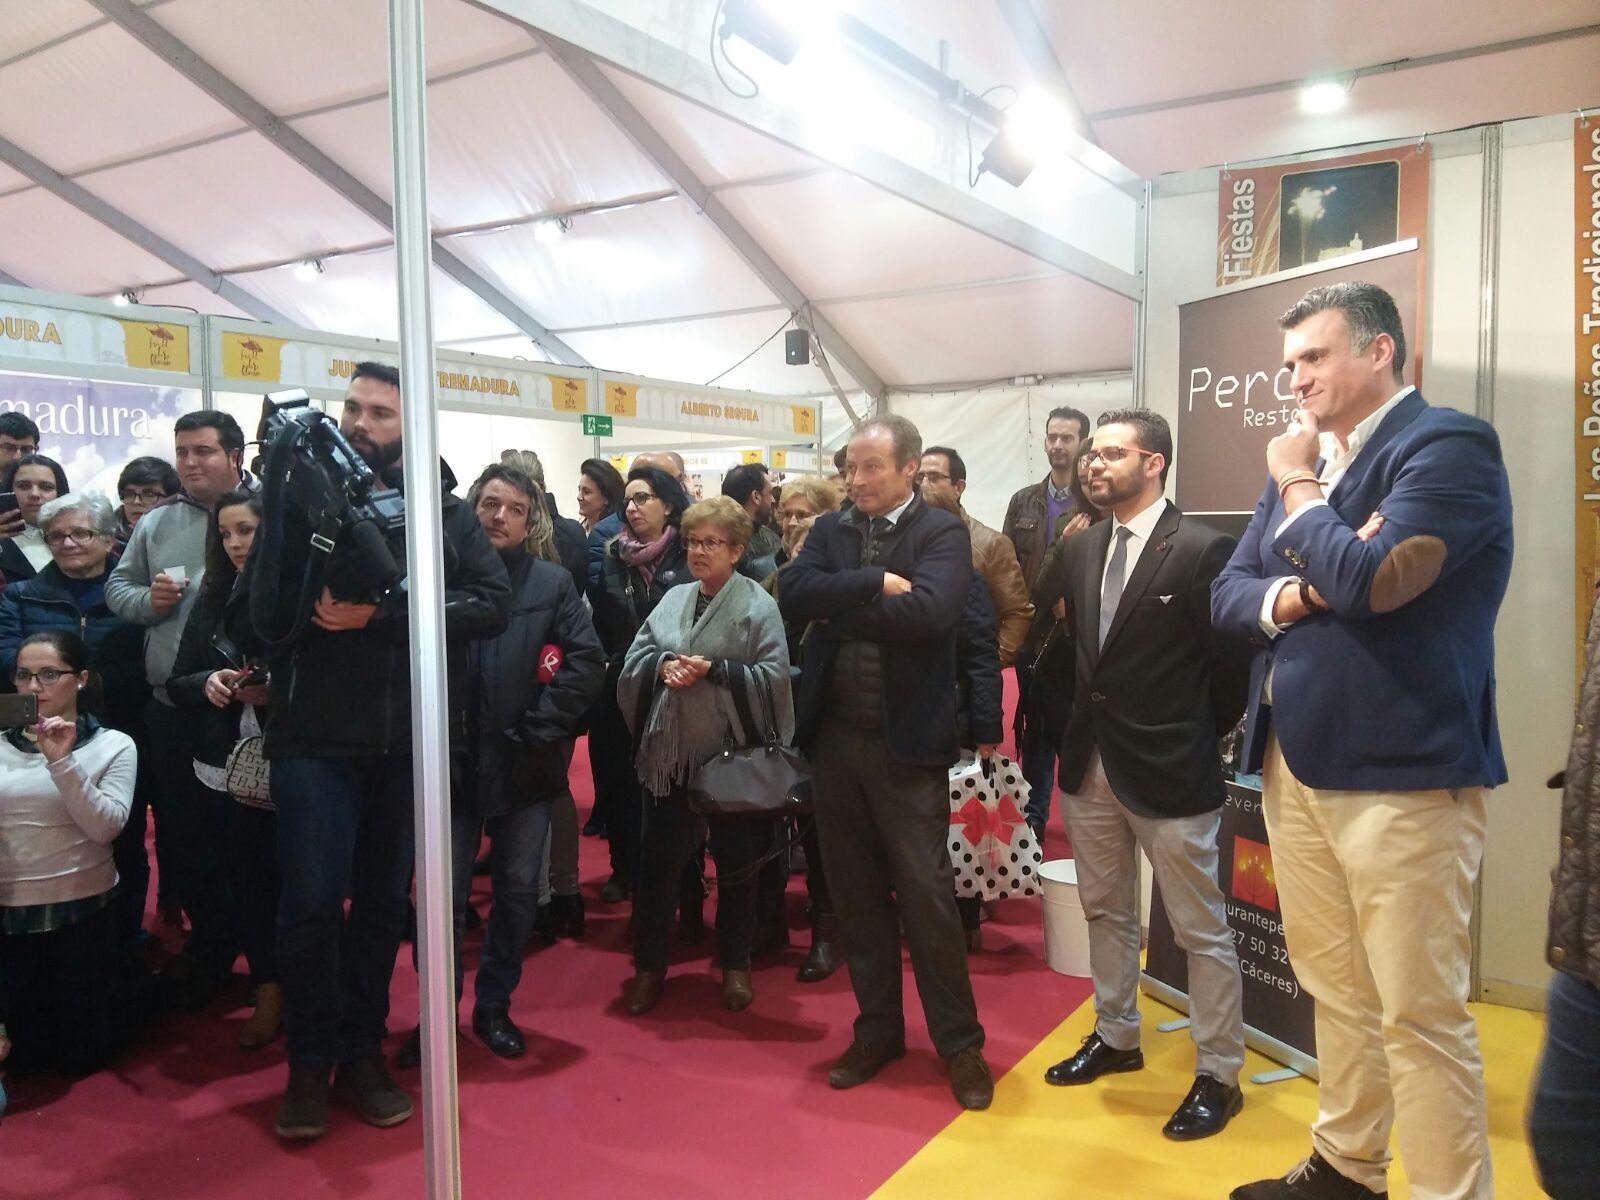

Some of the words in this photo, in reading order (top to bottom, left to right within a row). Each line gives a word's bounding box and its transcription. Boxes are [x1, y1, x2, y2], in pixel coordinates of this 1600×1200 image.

[1223, 178, 1256, 278] Fiestas
[437, 370, 520, 397] REMADURA
[1250, 936, 1266, 955] 50
[1271, 945, 1288, 965] 32
[1237, 956, 1299, 999] Cáceres)
